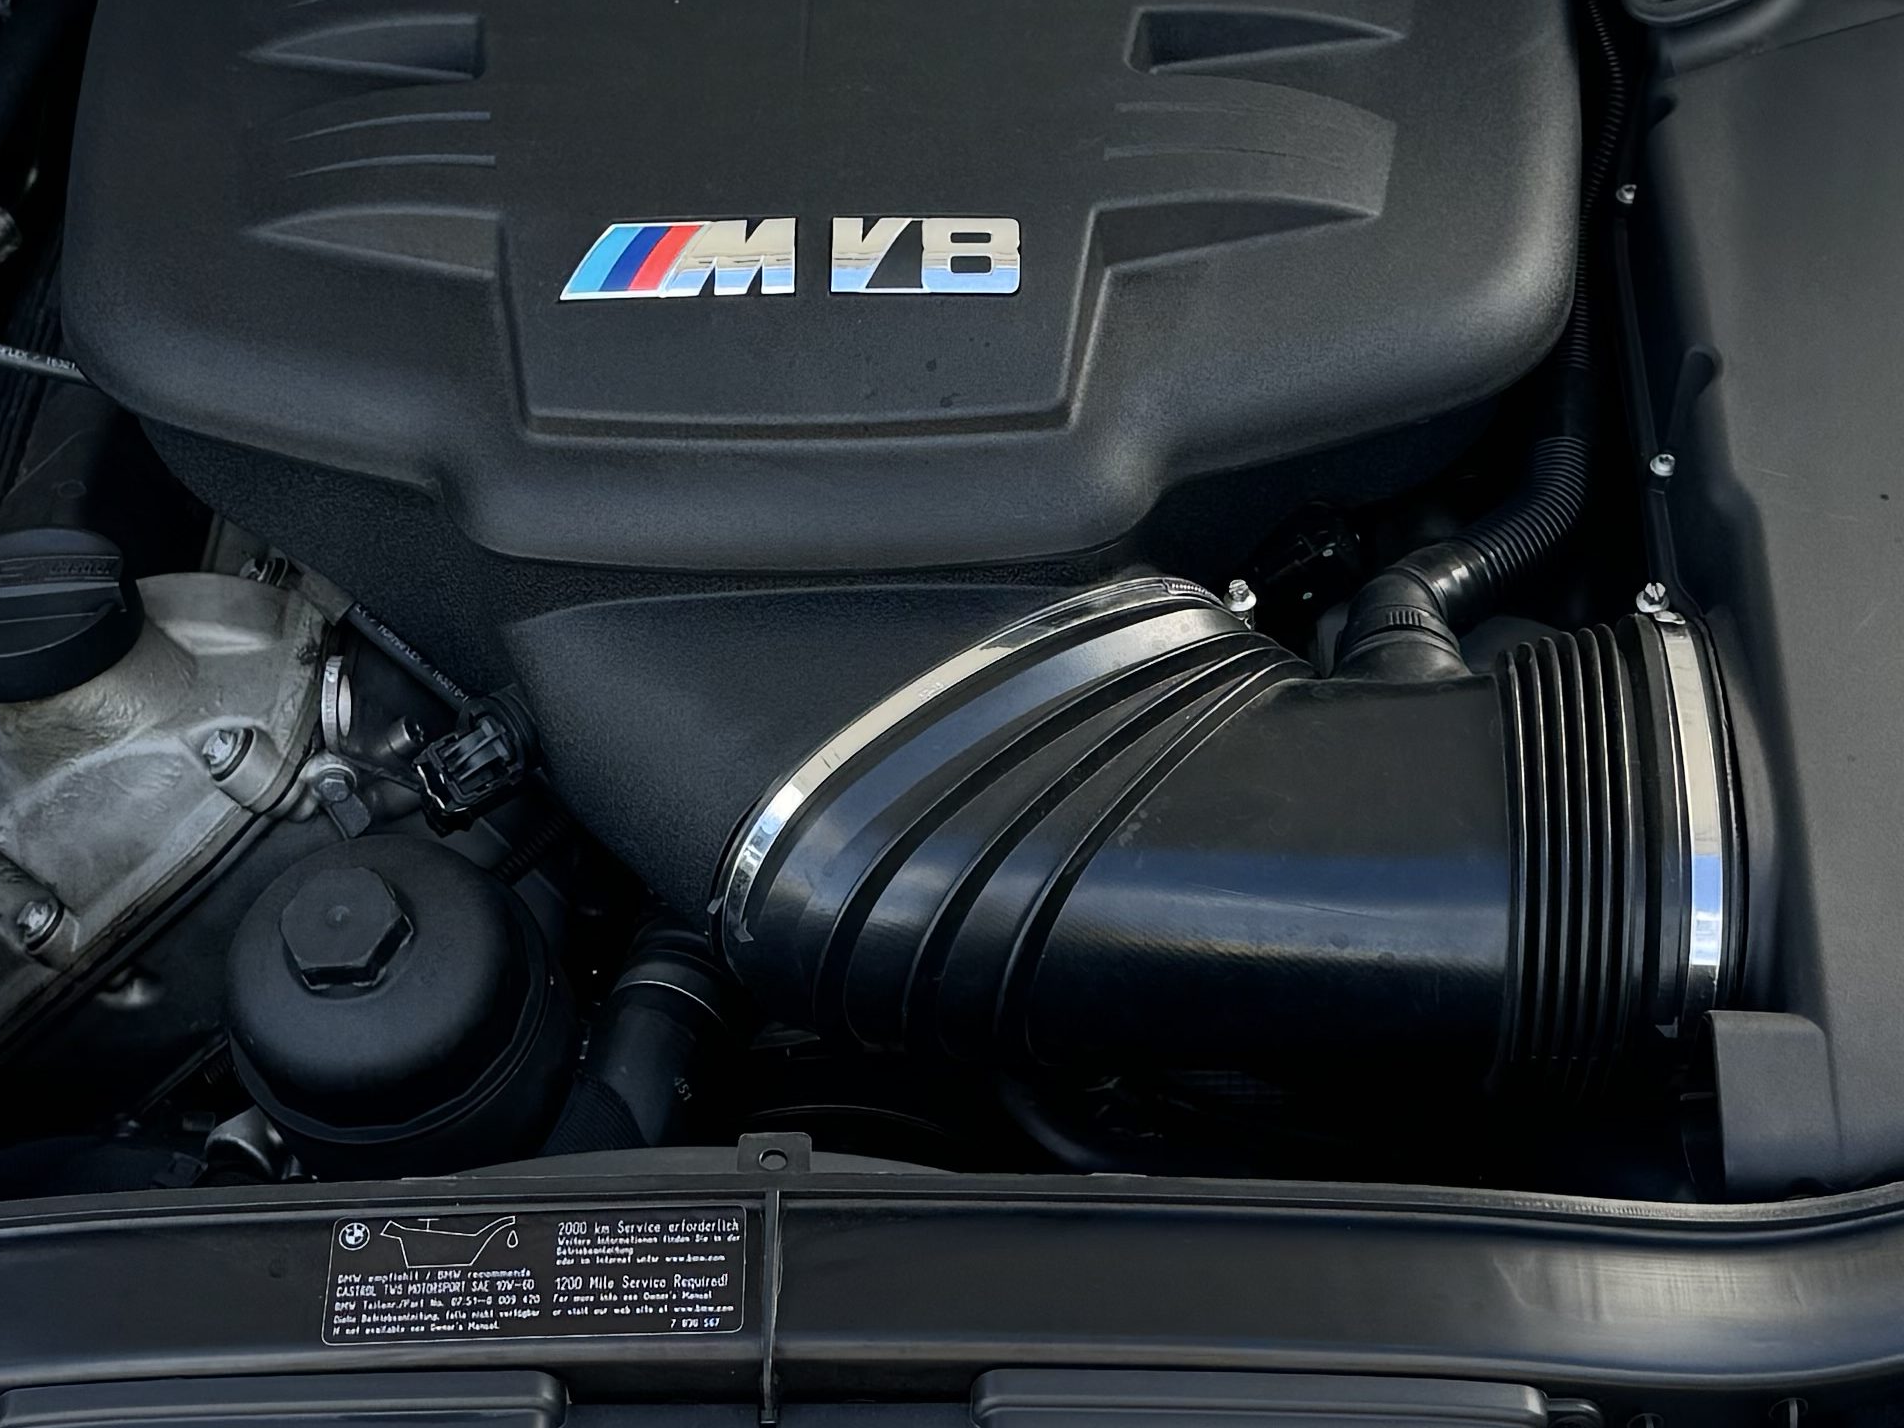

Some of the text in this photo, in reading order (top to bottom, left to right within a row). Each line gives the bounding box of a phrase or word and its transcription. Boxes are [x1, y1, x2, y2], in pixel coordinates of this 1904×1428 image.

[830, 217, 1021, 293] V8
[558, 1217, 739, 1235] 2000 km Service erforderlich
[437, 1269, 462, 1280] BMW
[554, 1275, 583, 1290] 1200
[589, 1274, 615, 1290] Mile
[621, 1274, 667, 1289] Service
[336, 1284, 377, 1298] CASTROL
[407, 1281, 466, 1295] MOTORSPORT
[471, 1280, 490, 1293] SAE
